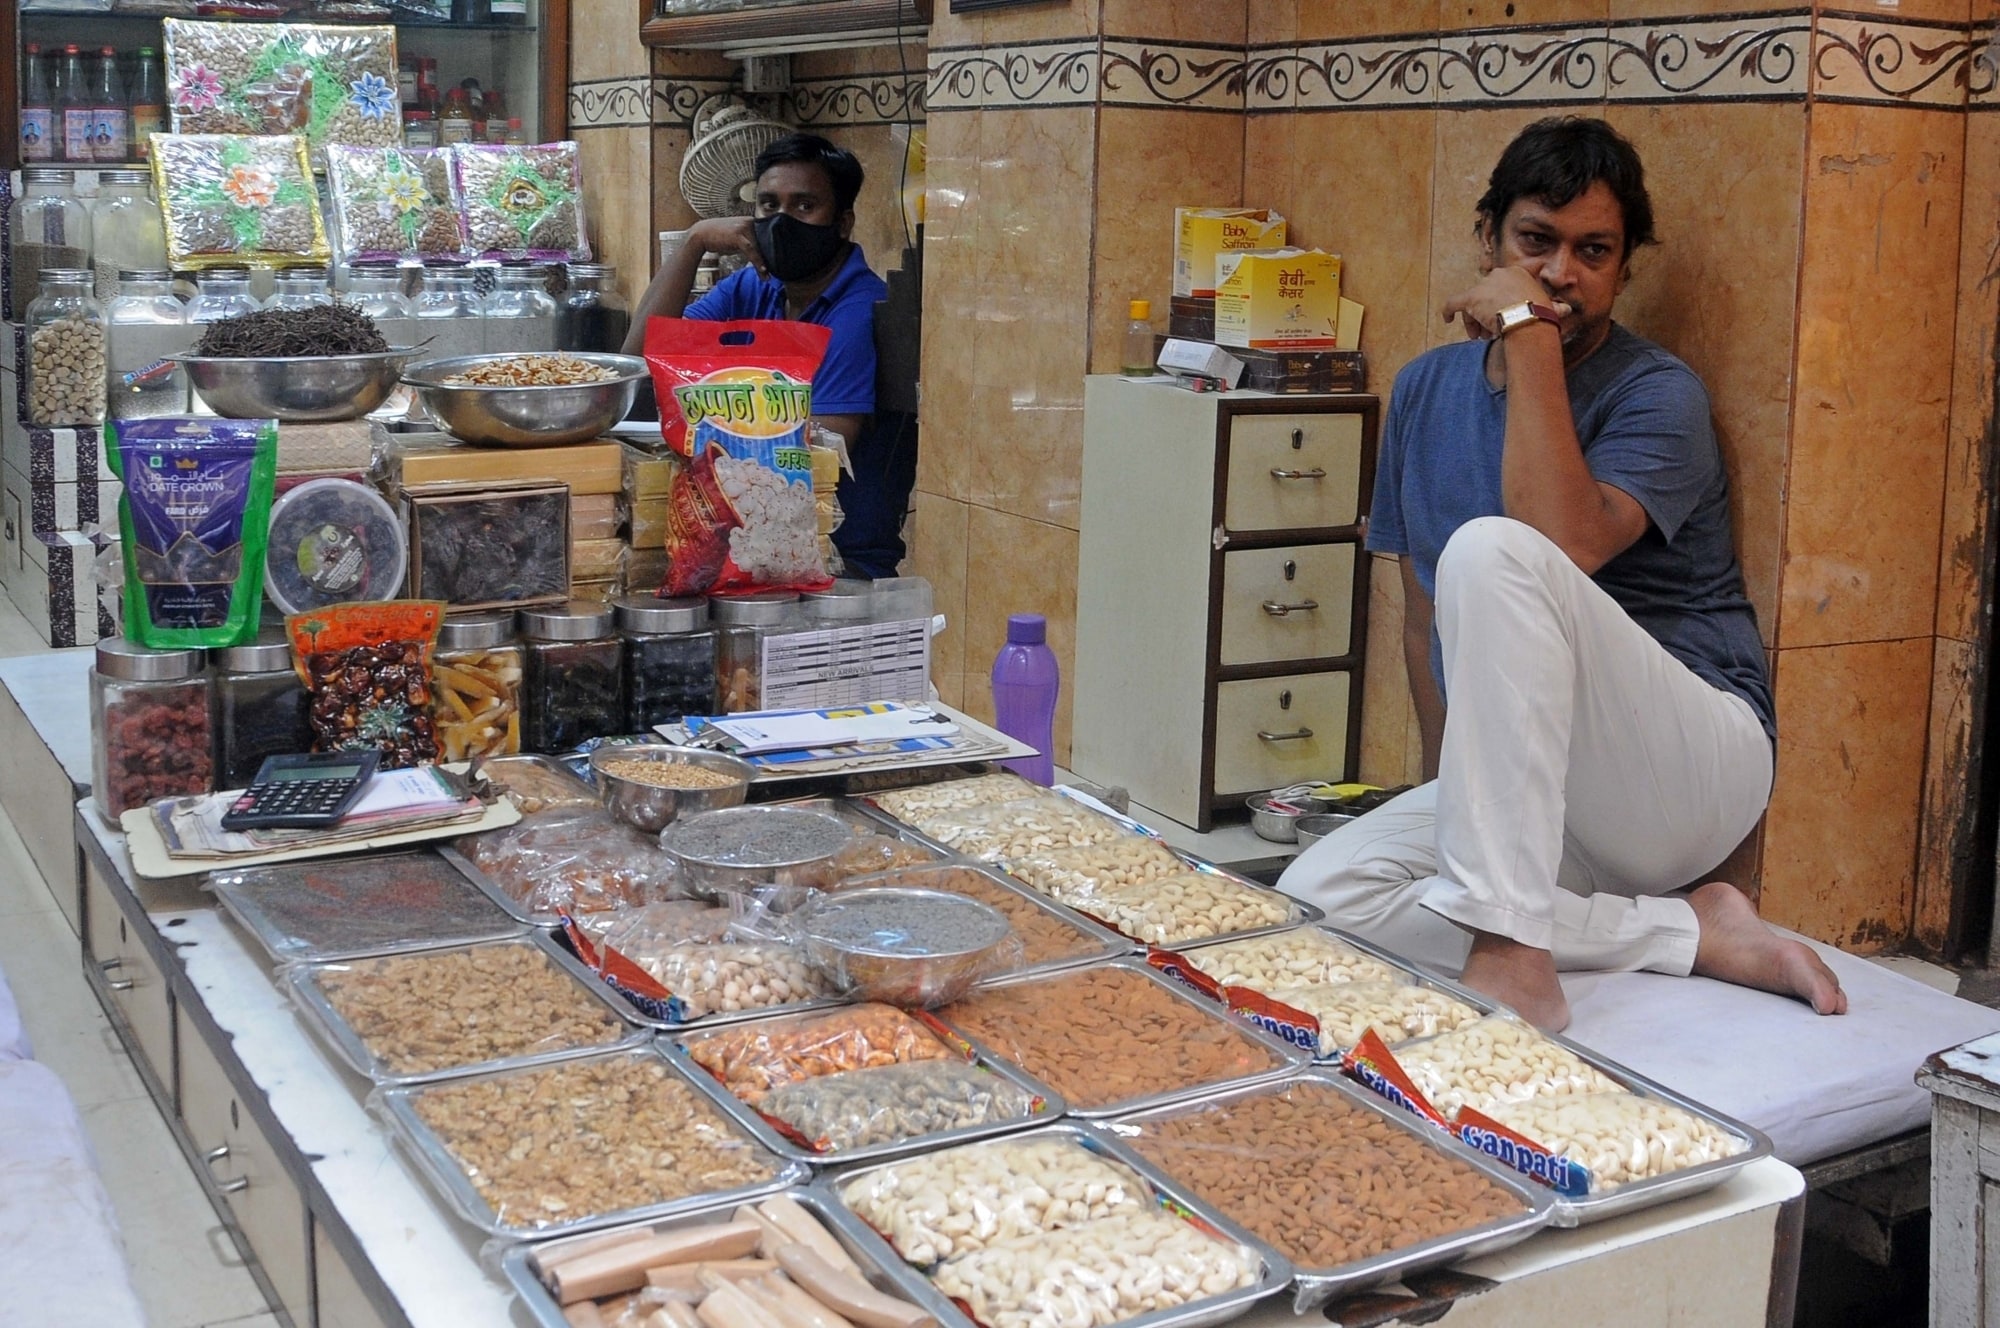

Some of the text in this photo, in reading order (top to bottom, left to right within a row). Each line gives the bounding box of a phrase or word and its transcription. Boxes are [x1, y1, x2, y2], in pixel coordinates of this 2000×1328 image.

[1223, 223, 1248, 241] Baby
[1222, 239, 1255, 249] Saffron
[1279, 269, 1305, 287] बेबी
[1278, 288, 1304, 299] केसर
[674, 384, 755, 425] छप्पन
[150, 482, 224, 493] DATE CROWN
[818, 665, 875, 679] NEW ARRIVALS
[1461, 1124, 1571, 1189] Ganpati
